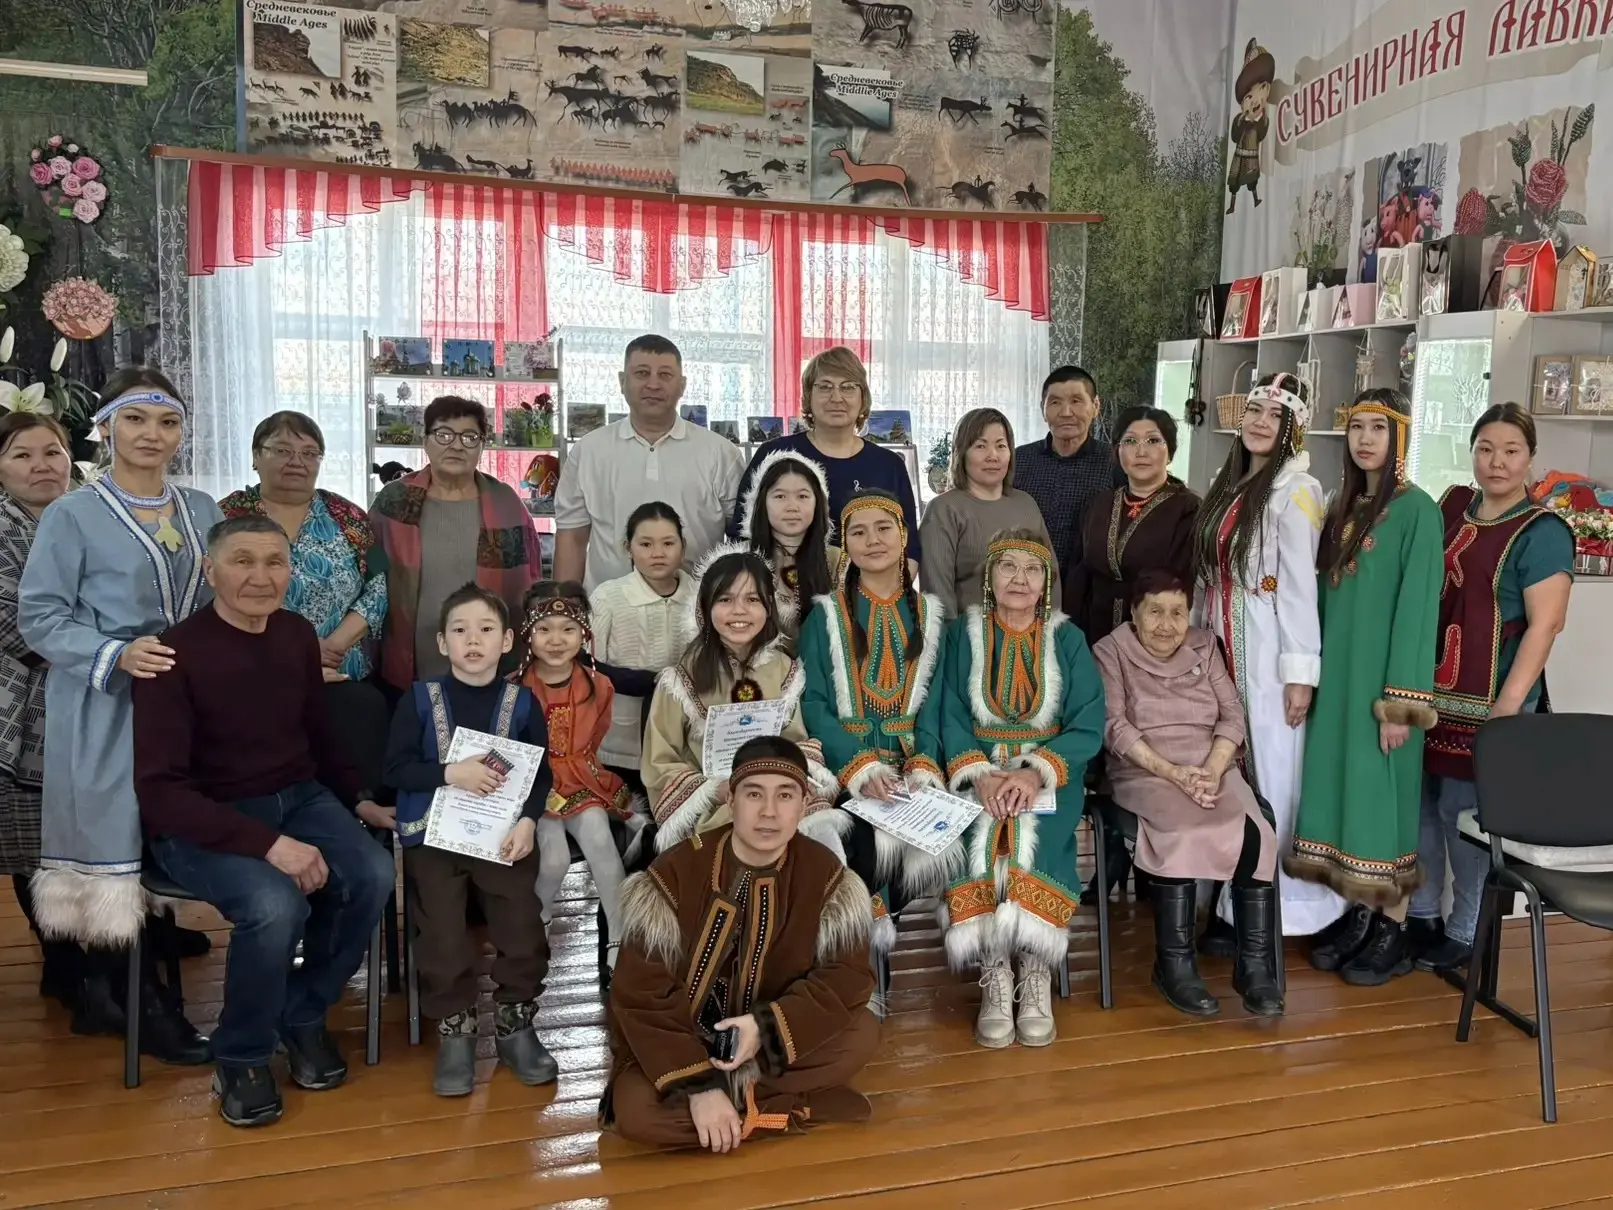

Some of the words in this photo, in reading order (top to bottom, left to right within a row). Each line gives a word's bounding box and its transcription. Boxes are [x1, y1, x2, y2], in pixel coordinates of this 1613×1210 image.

[246, 0, 337, 17] Средневековье
[256, 12, 297, 26] Middle
[299, 18, 328, 29] Ages
[1277, 9, 1466, 143] СУВЕНИРНАЯ
[1488, 0, 1613, 56] ЛАВК
[830, 73, 903, 88] Средневековье
[874, 88, 898, 99] Ages
